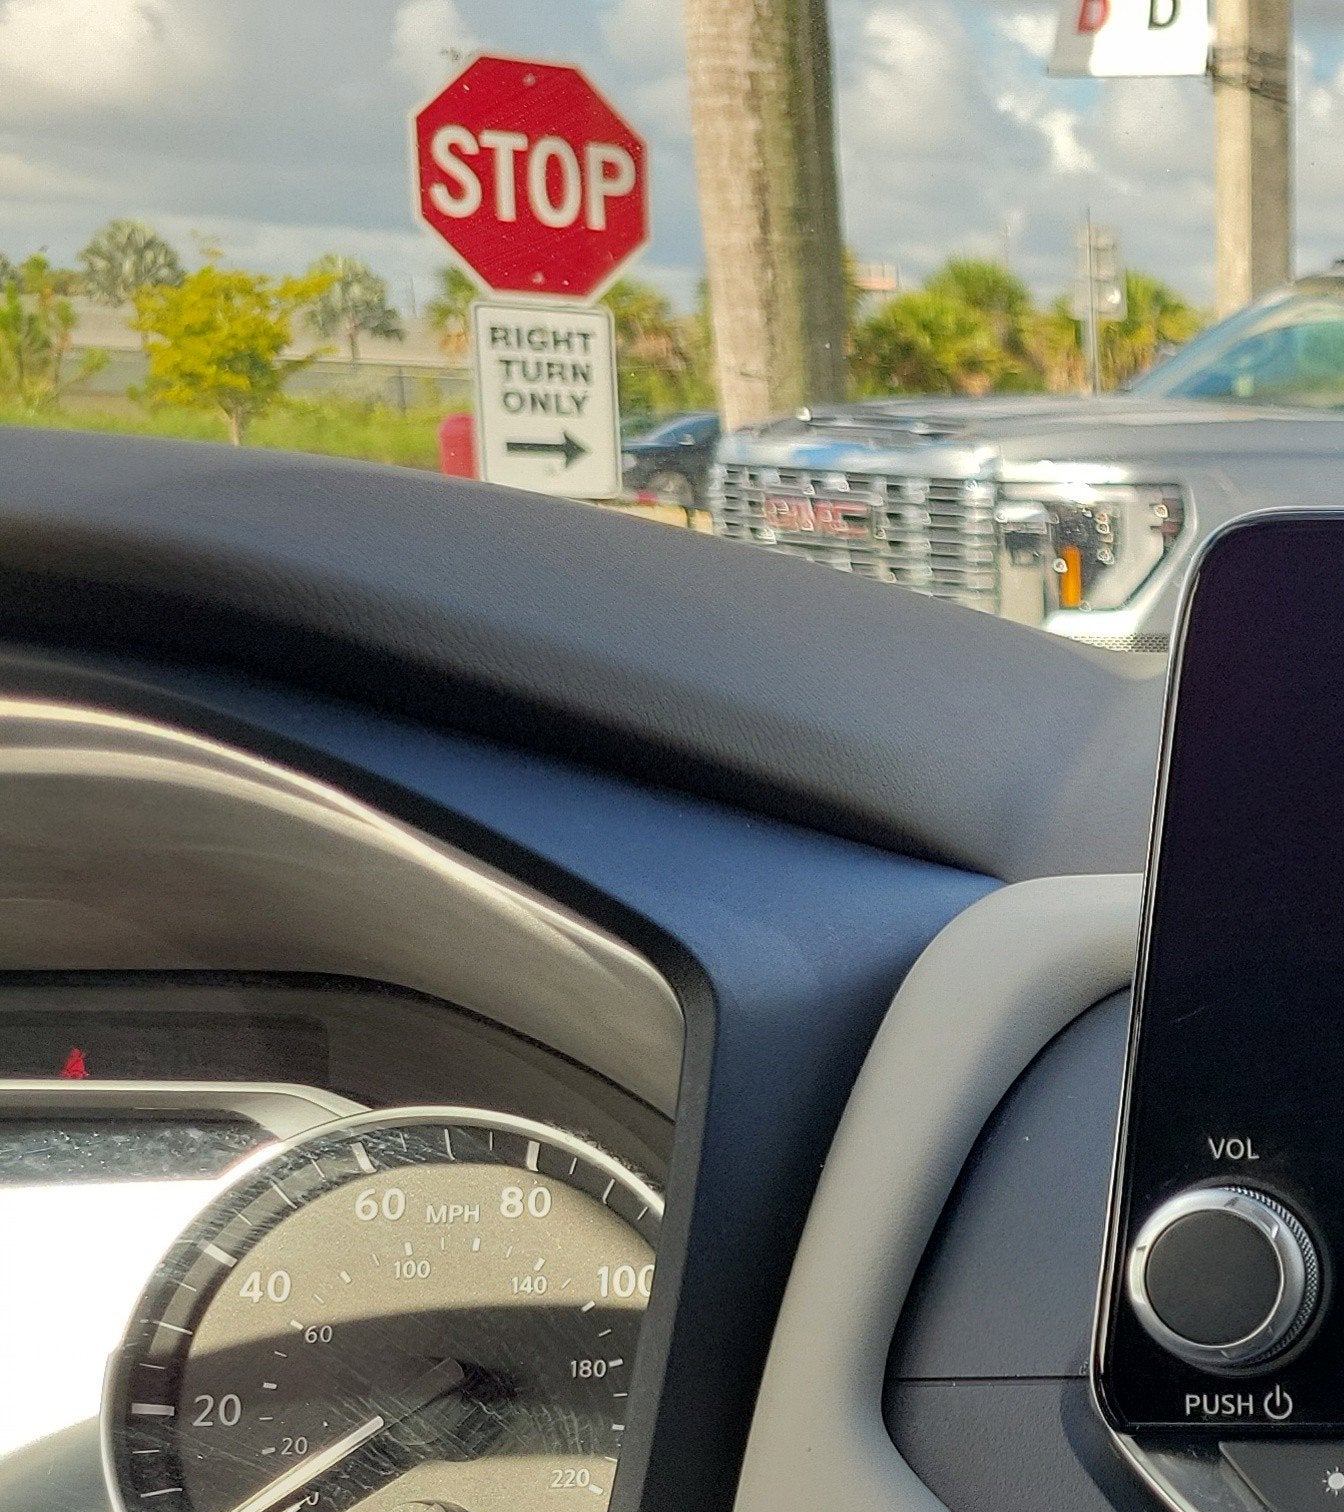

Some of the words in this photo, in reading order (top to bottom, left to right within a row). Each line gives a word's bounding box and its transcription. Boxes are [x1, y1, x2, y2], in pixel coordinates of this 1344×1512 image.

[430, 125, 637, 231] STOP
[490, 327, 595, 351] RIGHT
[500, 359, 591, 385] TURN
[502, 390, 590, 416] ONLY
[1209, 1138, 1259, 1159] VOL
[355, 1188, 406, 1221] 60
[426, 1205, 481, 1225] MPH
[500, 1187, 552, 1219] 80
[395, 1260, 431, 1279] 100
[239, 1270, 291, 1303] 40
[512, 1275, 547, 1295] 140
[598, 1264, 653, 1298] 100
[304, 1325, 333, 1344] 60
[571, 1360, 606, 1378] 180
[192, 1393, 242, 1426] 20
[1186, 1394, 1253, 1415] PUSH
[281, 1437, 309, 1455] 20
[552, 1469, 590, 1488] 220
